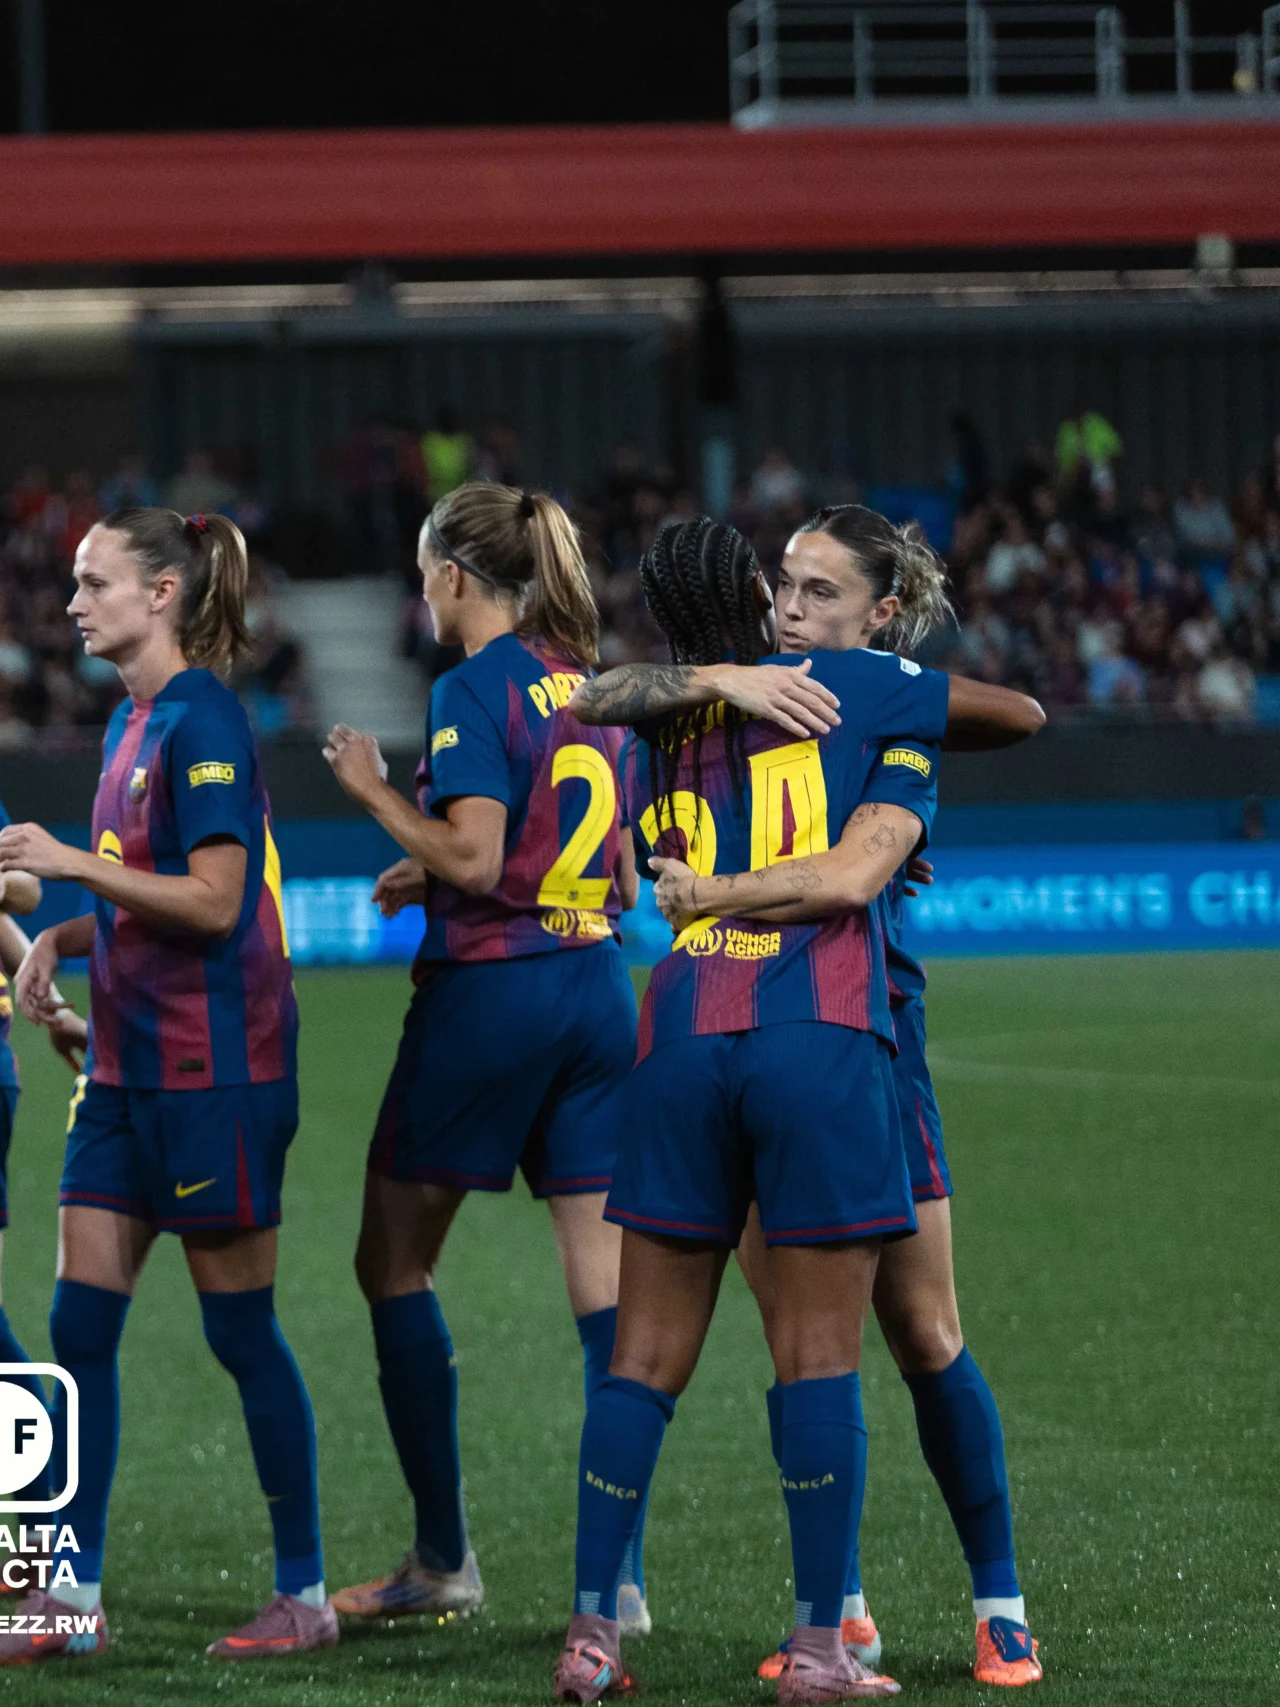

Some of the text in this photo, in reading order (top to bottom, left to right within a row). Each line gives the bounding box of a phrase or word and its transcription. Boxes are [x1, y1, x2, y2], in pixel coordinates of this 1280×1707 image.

[883, 750, 930, 776] BIMBO
[537, 744, 615, 909] 2
[1188, 870, 1280, 928] CH
[724, 940, 781, 956] ACNUR
[725, 928, 781, 945] UNHCR
